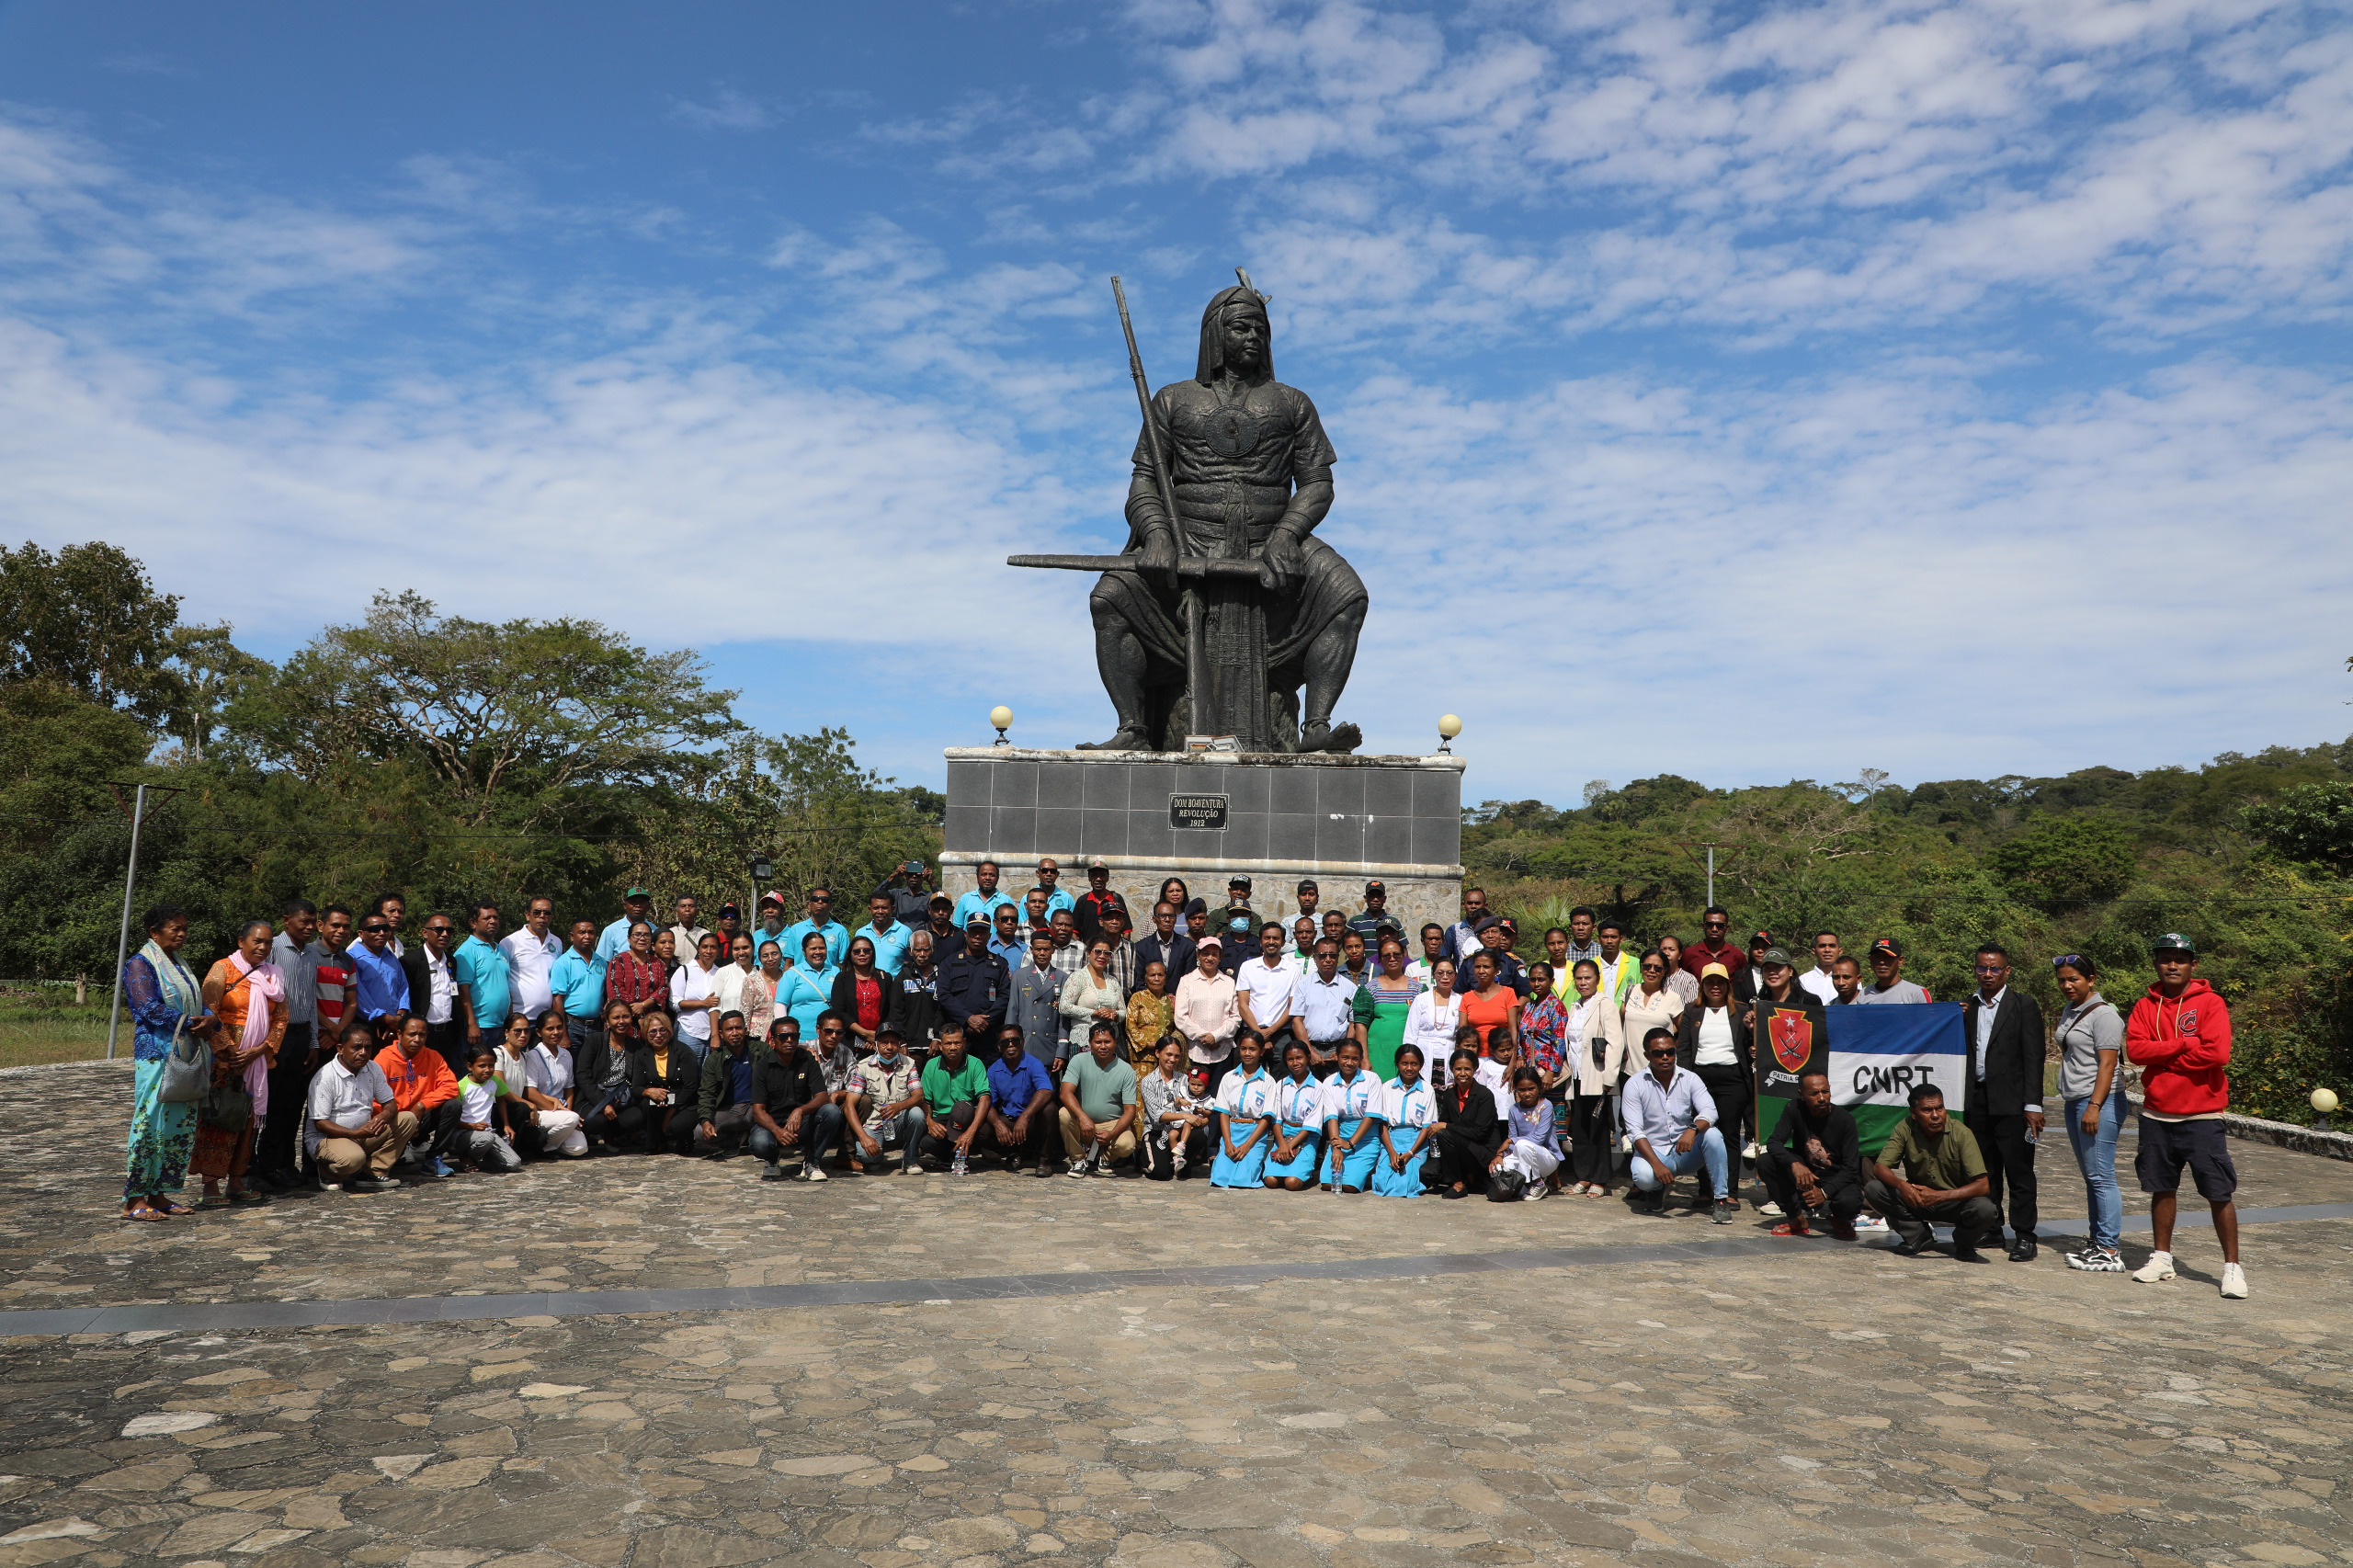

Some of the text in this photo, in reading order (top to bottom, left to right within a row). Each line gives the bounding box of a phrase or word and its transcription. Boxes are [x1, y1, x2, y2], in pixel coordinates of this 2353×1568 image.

[1174, 799, 1224, 809] DOM BOAVENTURA
[1178, 809, 1219, 819] REVOLUÇÃO
[1773, 1072, 1793, 1081] PATRIA
[1853, 1065, 1934, 1095] CNRT
